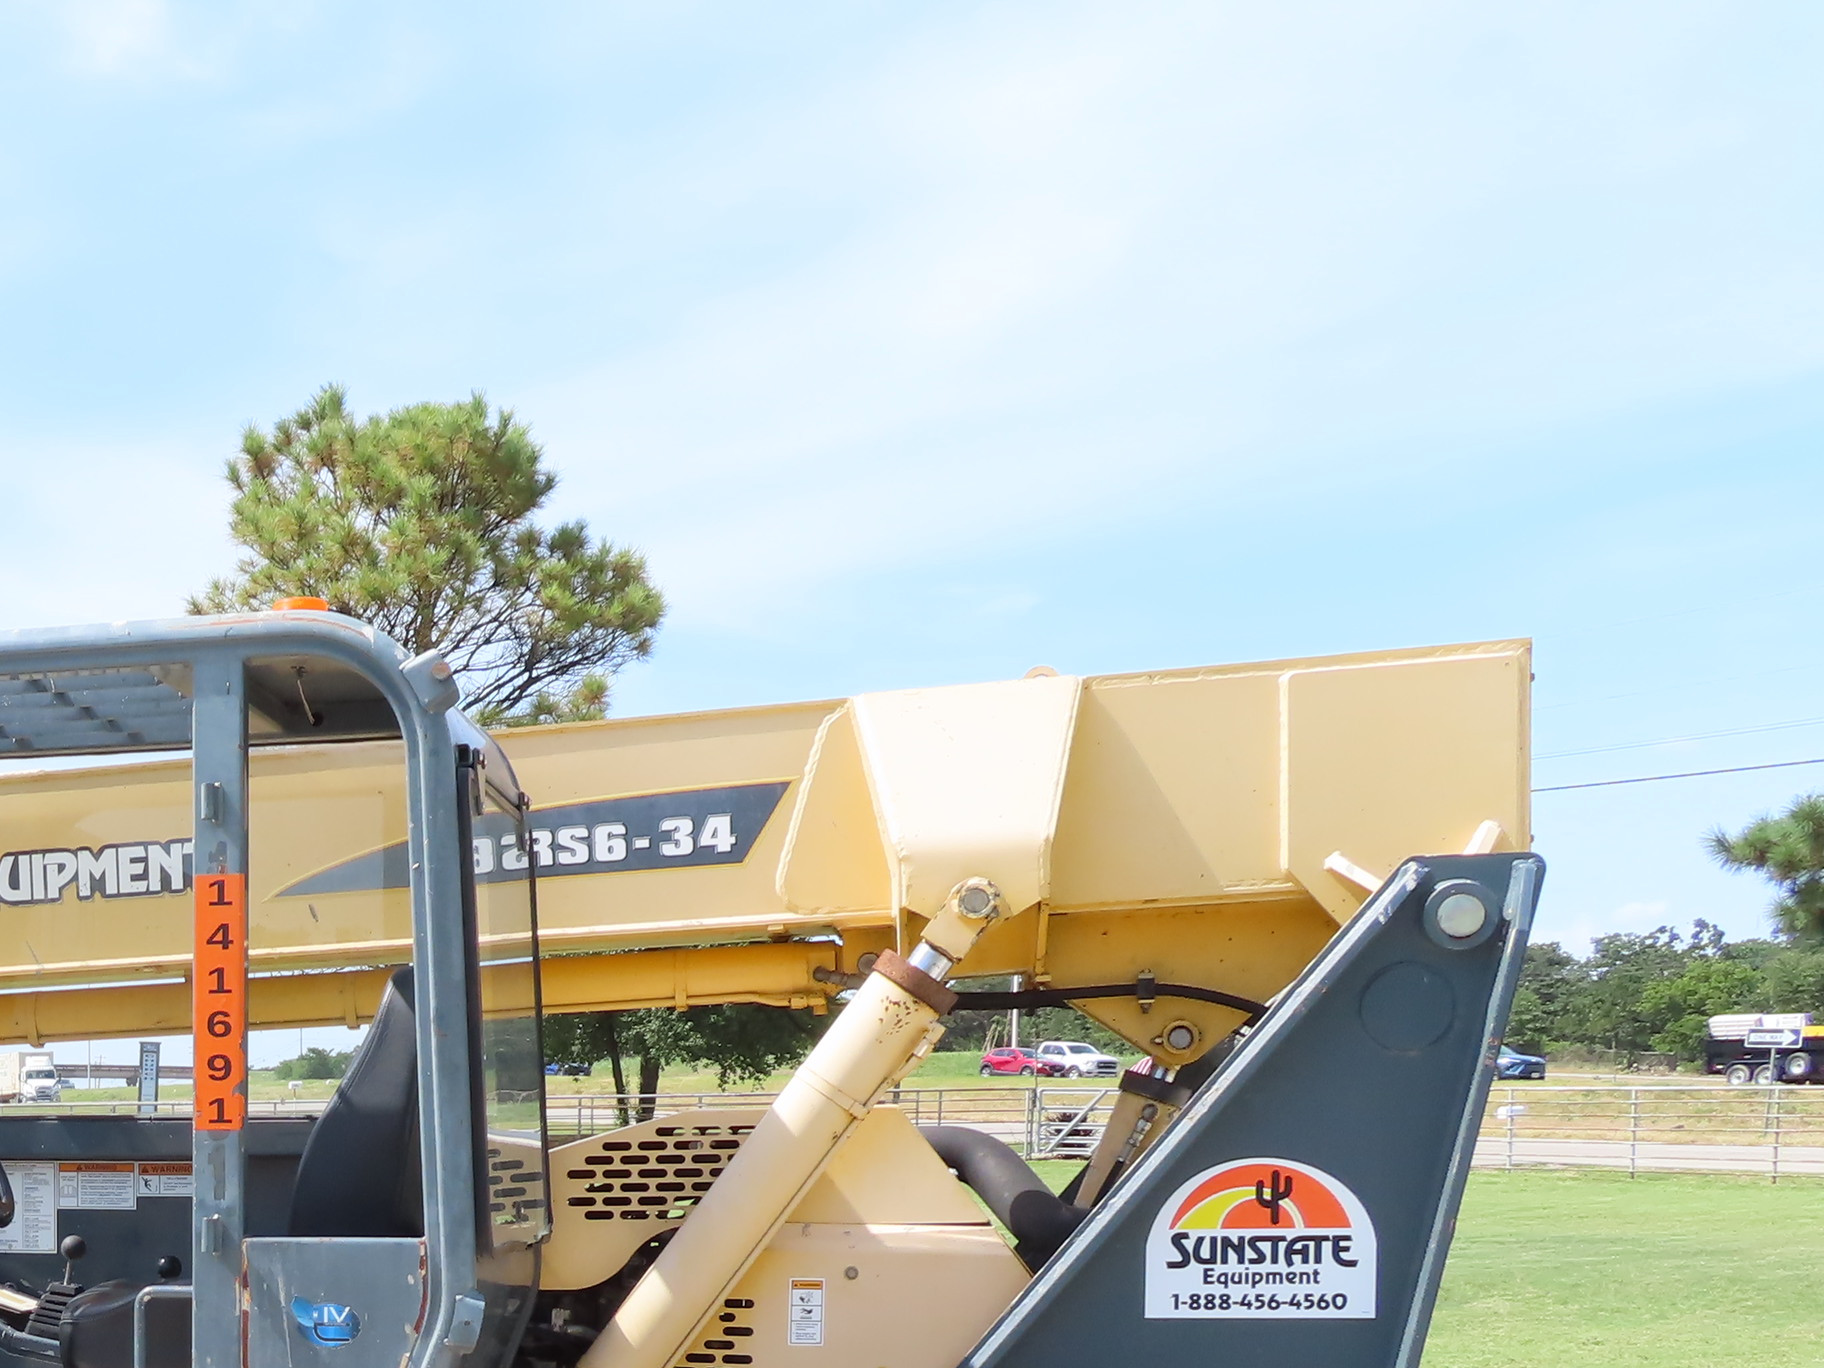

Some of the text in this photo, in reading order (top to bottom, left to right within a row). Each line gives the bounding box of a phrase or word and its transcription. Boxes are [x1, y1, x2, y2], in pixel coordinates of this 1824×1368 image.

[206, 879, 234, 1124] 141691
[1166, 1232, 1359, 1269] SUNSTATE
[1202, 1268, 1320, 1289] Equipment
[1169, 1293, 1348, 1311] 1-888-456-4560
